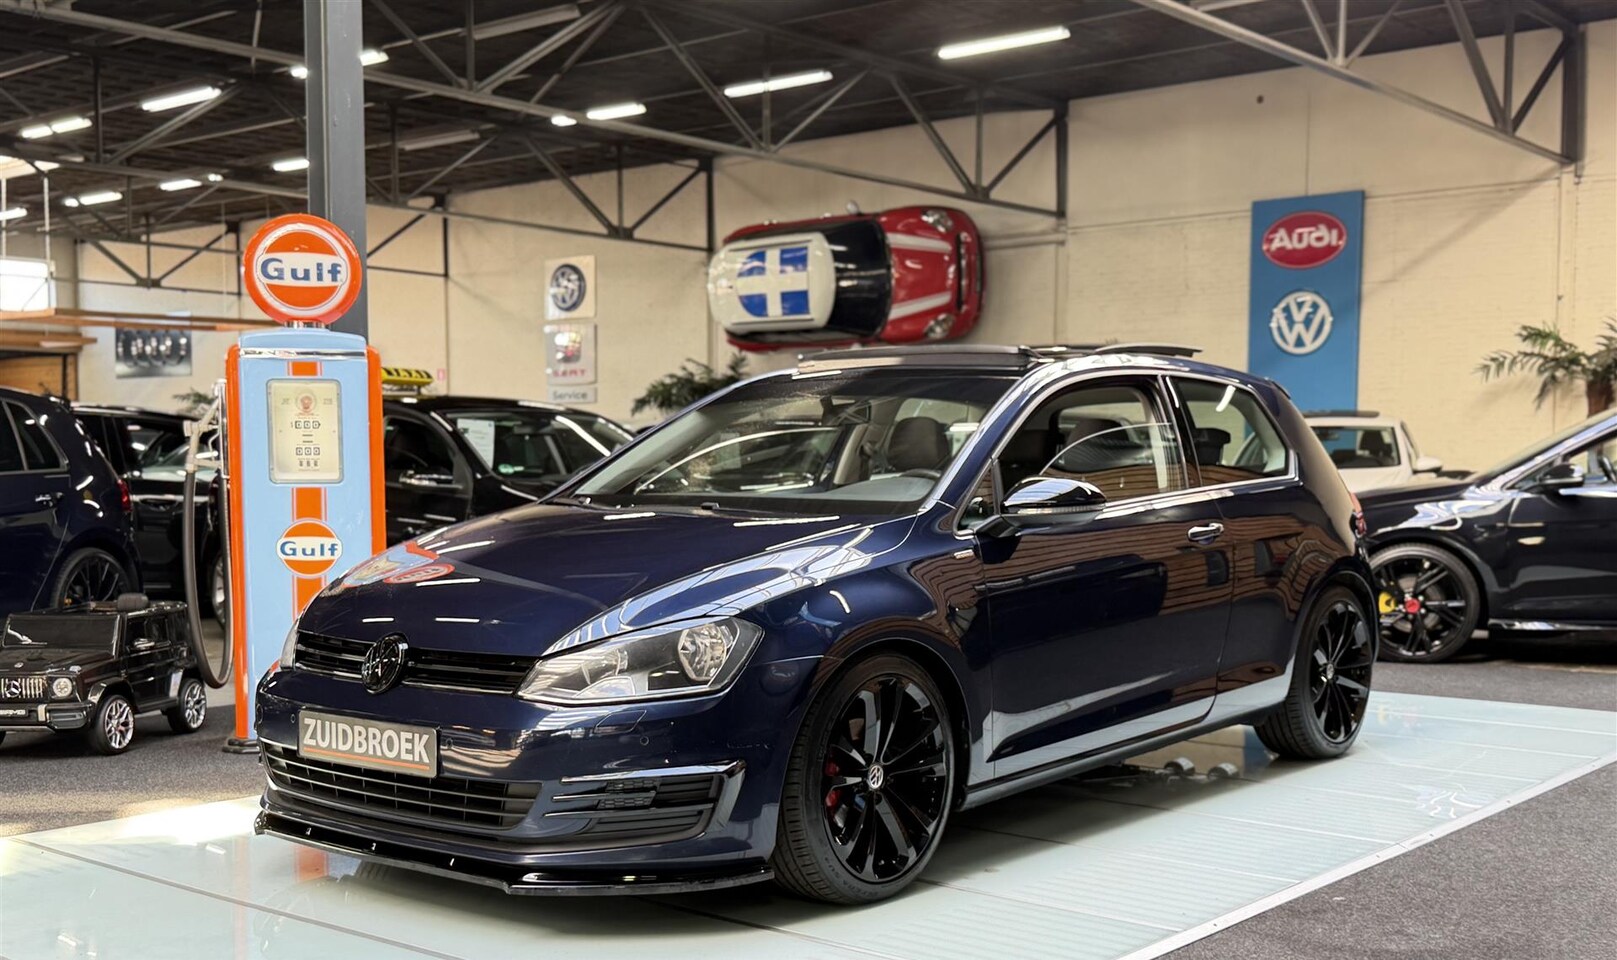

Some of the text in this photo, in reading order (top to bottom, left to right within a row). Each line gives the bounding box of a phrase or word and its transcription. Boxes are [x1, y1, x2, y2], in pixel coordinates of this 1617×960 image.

[260, 257, 342, 282] Gulf
[553, 390, 588, 401] Service
[280, 540, 338, 557] Gulf
[303, 717, 430, 763] ZUIDBROEK
